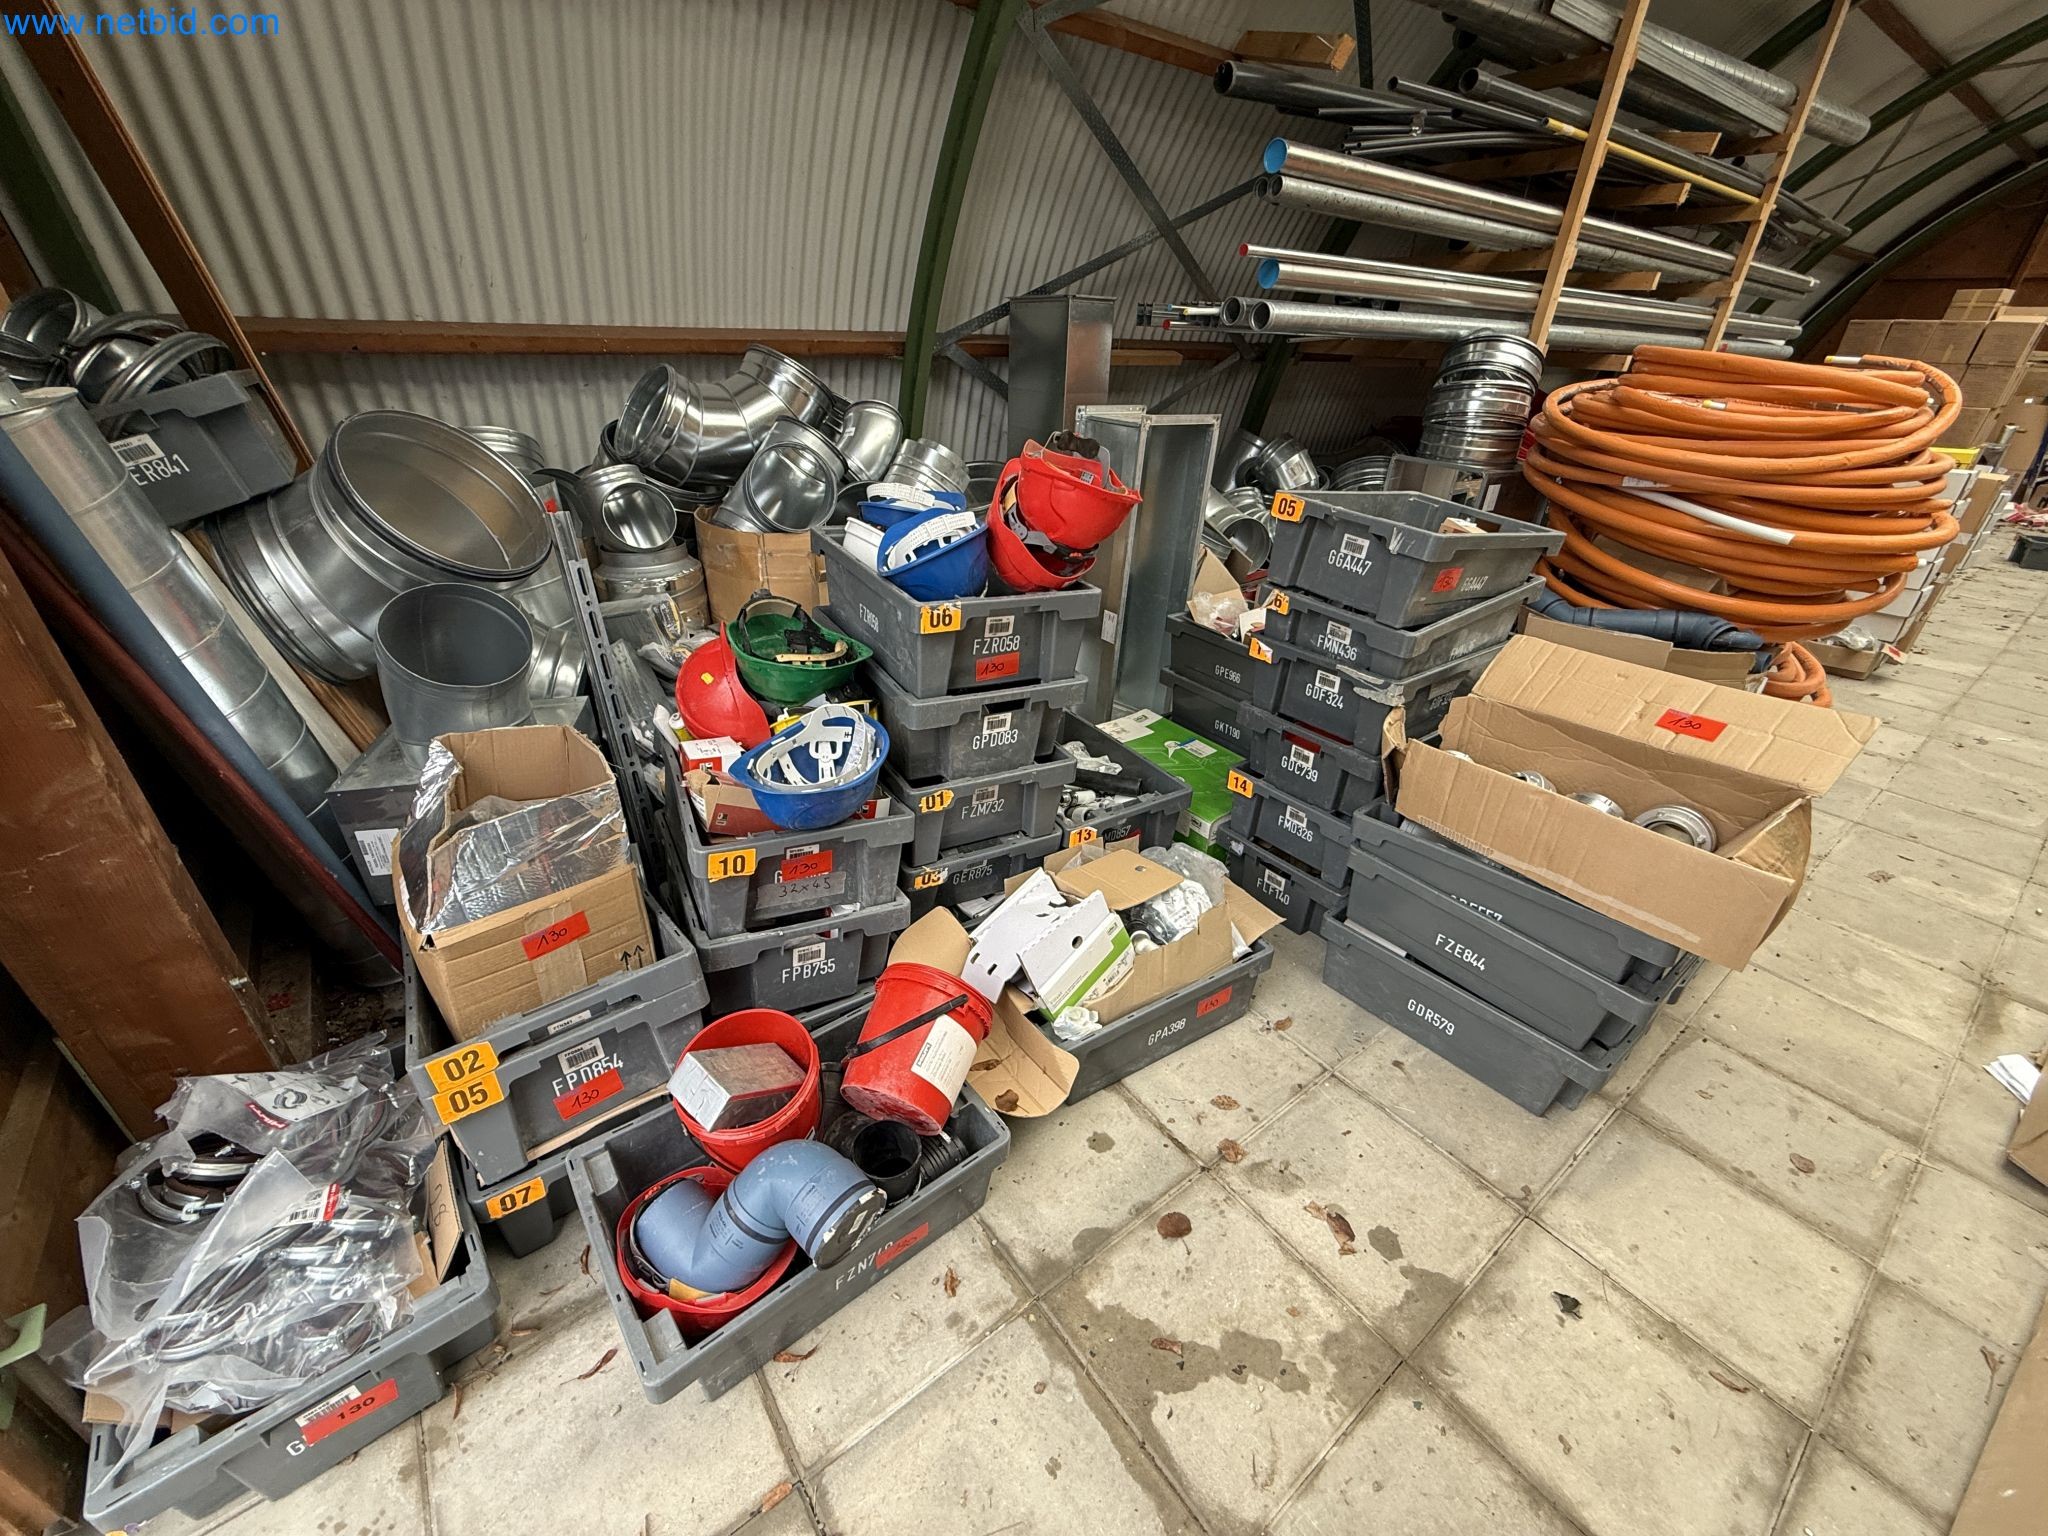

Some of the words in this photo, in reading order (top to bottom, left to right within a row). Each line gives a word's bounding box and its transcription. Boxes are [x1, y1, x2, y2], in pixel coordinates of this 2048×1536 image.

[1278, 498, 1297, 517] 05
[1327, 549, 1372, 576] GGA447
[858, 602, 880, 634] FZR058
[972, 635, 1021, 656] FZR058
[1316, 634, 1358, 661] FMN436
[980, 661, 1005, 677] 130
[1305, 683, 1344, 709] GDF324
[1214, 719, 1241, 740] GKT190
[1667, 716, 1702, 730] 130
[972, 728, 1019, 750] GPD083
[1281, 755, 1318, 782] GDC739
[1233, 776, 1248, 792] 14
[961, 798, 1005, 820] FZM732
[1076, 828, 1092, 843] 13
[1278, 815, 1314, 842] FMD326
[718, 854, 746, 876] 10
[788, 861, 819, 875] 130
[952, 863, 993, 886] GER875
[1256, 878, 1290, 906] FLF140
[536, 926, 568, 951] 130
[1434, 933, 1486, 972] FZE844
[781, 958, 836, 984] FPB755
[1407, 998, 1455, 1036] GDR579
[1147, 1017, 1187, 1046] GPA398
[442, 1049, 486, 1082] 02
[448, 1081, 489, 1114] 05
[572, 1088, 600, 1109] 130
[499, 1185, 532, 1213] 07
[336, 1396, 376, 1421] 130
